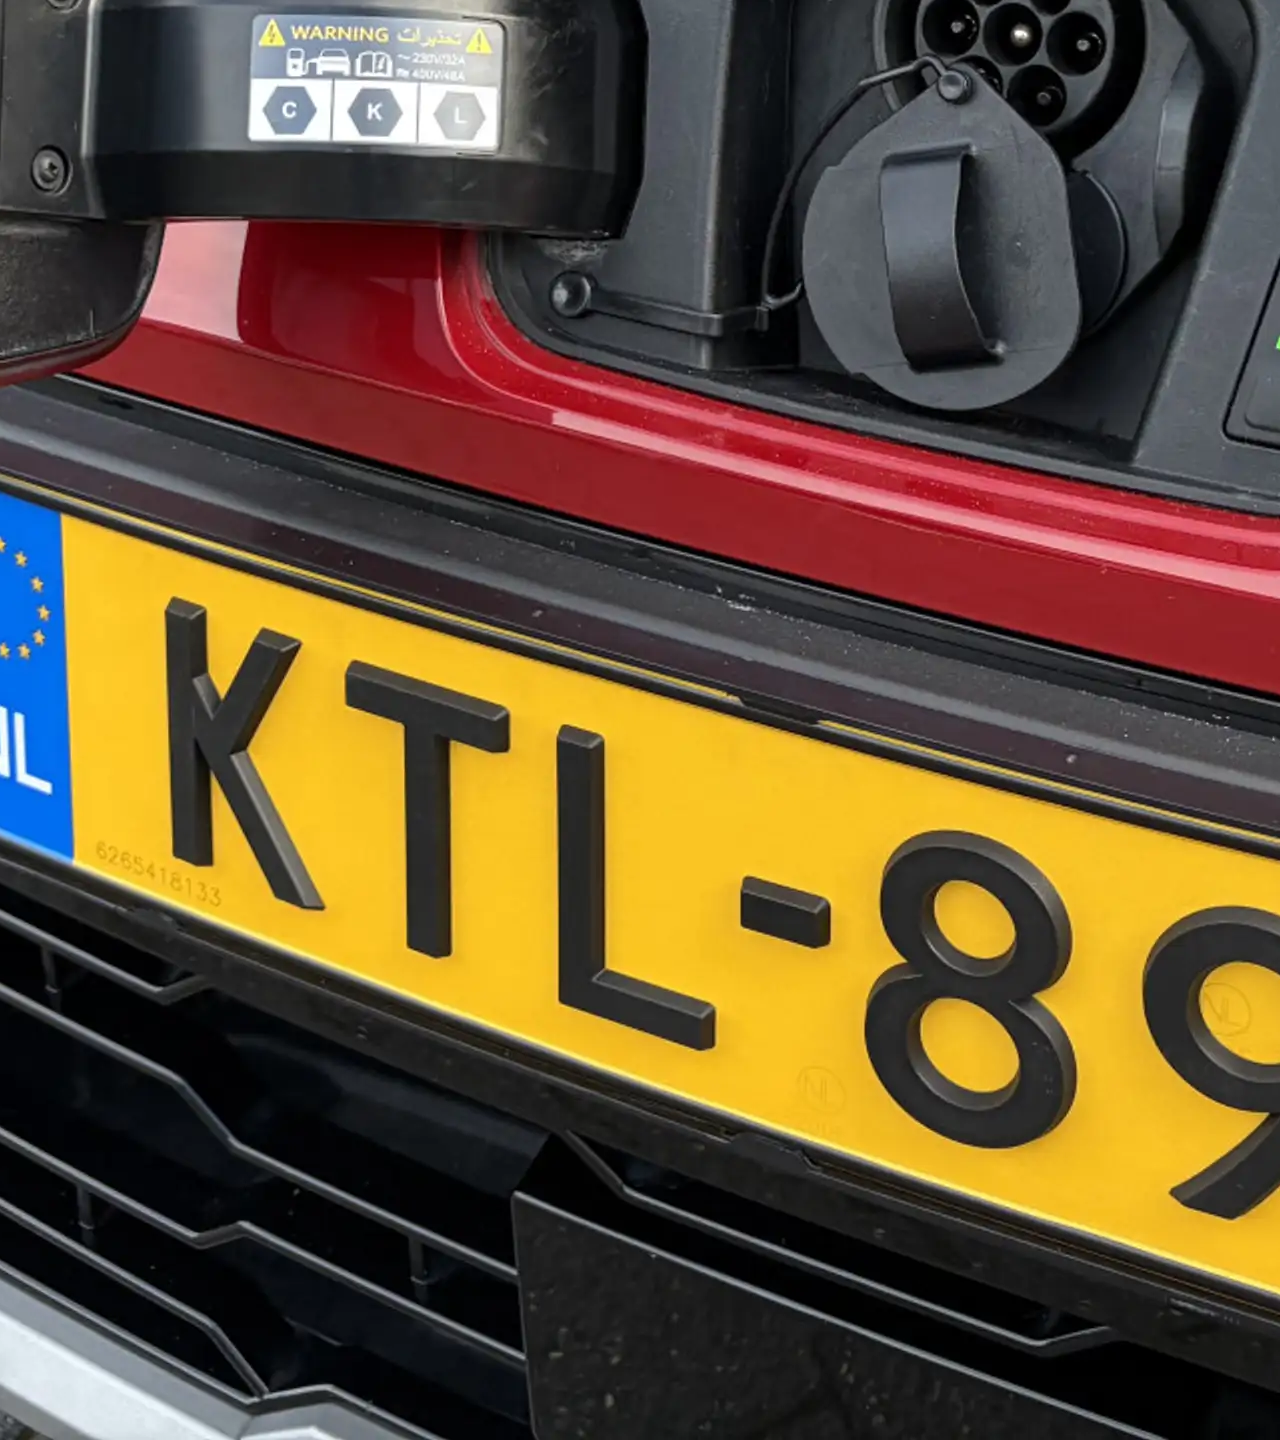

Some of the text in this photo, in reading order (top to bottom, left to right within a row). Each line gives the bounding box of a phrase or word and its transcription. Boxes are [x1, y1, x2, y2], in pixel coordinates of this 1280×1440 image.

[290, 24, 390, 44] WARNING
[281, 101, 297, 119] C
[367, 103, 383, 121] K
[454, 106, 468, 125] L
[95, 840, 222, 907] 6265418133
